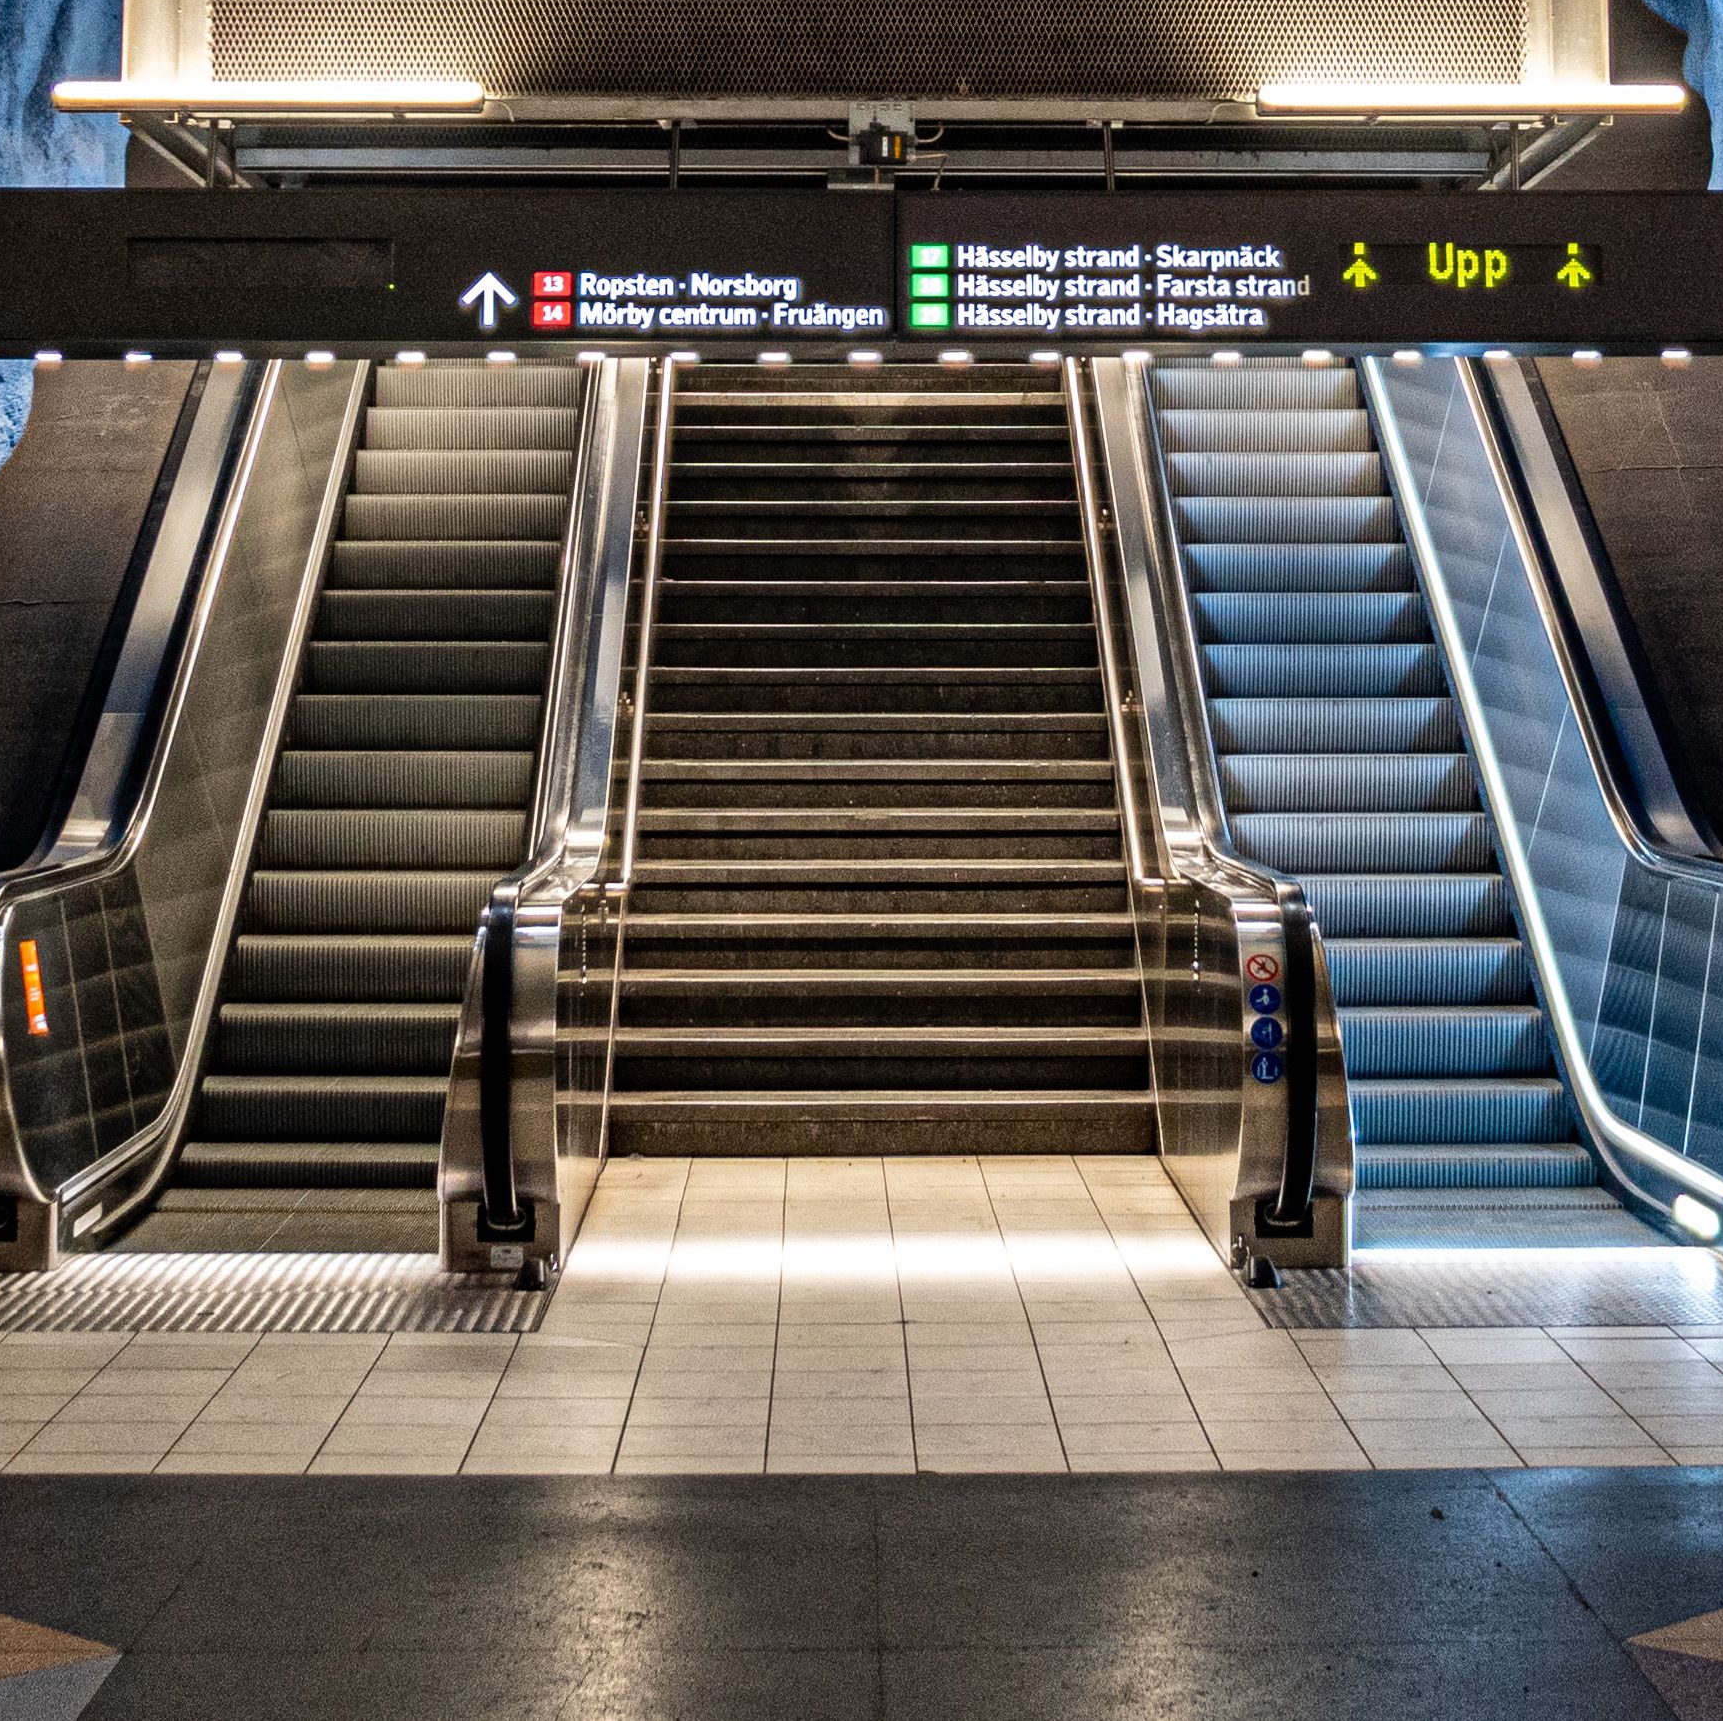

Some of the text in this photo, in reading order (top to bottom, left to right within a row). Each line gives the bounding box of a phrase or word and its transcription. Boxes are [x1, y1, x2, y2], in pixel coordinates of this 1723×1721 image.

[957, 245, 1060, 272] Hässelby
[1064, 244, 1140, 268] strand
[1156, 244, 1280, 272] Skarpnäck
[1428, 242, 1507, 287] Upp
[542, 275, 564, 292] 13
[580, 272, 675, 300] Ropsten
[691, 272, 797, 301] Norsborg
[957, 273, 1060, 301] Hässelby
[1065, 273, 1140, 297] strand
[1156, 274, 1231, 297] Farsta
[1235, 274, 1311, 297] strand
[542, 304, 564, 322] 14
[580, 301, 655, 329] Mörby
[658, 303, 757, 325] centrum
[773, 302, 884, 330] Fruängen
[957, 303, 1061, 330] Hässelby
[1065, 302, 1141, 326] strand
[1157, 303, 1264, 330] Hagsätra
